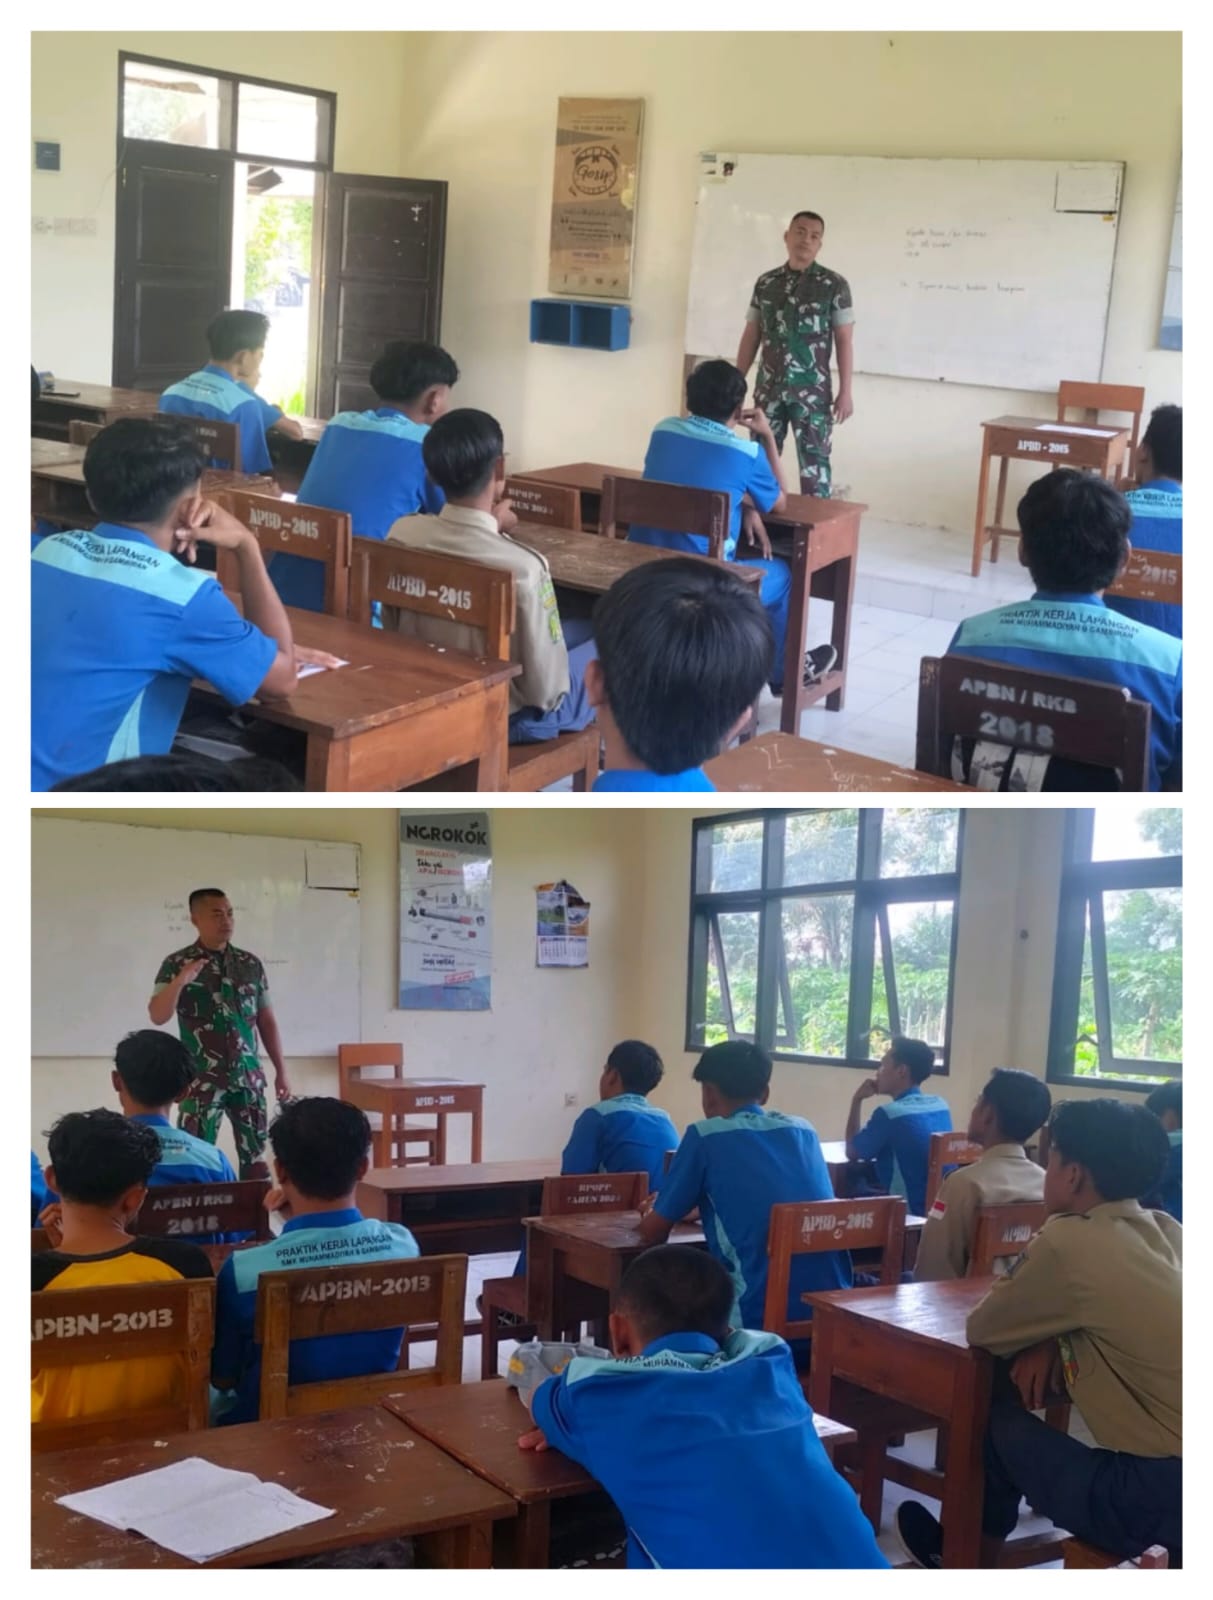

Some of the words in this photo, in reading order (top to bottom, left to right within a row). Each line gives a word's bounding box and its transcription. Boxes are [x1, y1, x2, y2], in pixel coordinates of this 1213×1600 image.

[1043, 609, 1077, 622] KERJA
[959, 678, 1016, 703] APBN
[1032, 691, 1078, 714] RKB
[978, 711, 1055, 747] 2018
[406, 823, 487, 845] NGROKOK
[152, 1195, 193, 1210] APBN
[203, 1194, 233, 1205] RKB
[167, 1215, 219, 1234] 2018
[276, 1243, 318, 1259] PRAKTIK
[320, 1238, 350, 1251] KERJA
[352, 1233, 393, 1248] LAPANGAN
